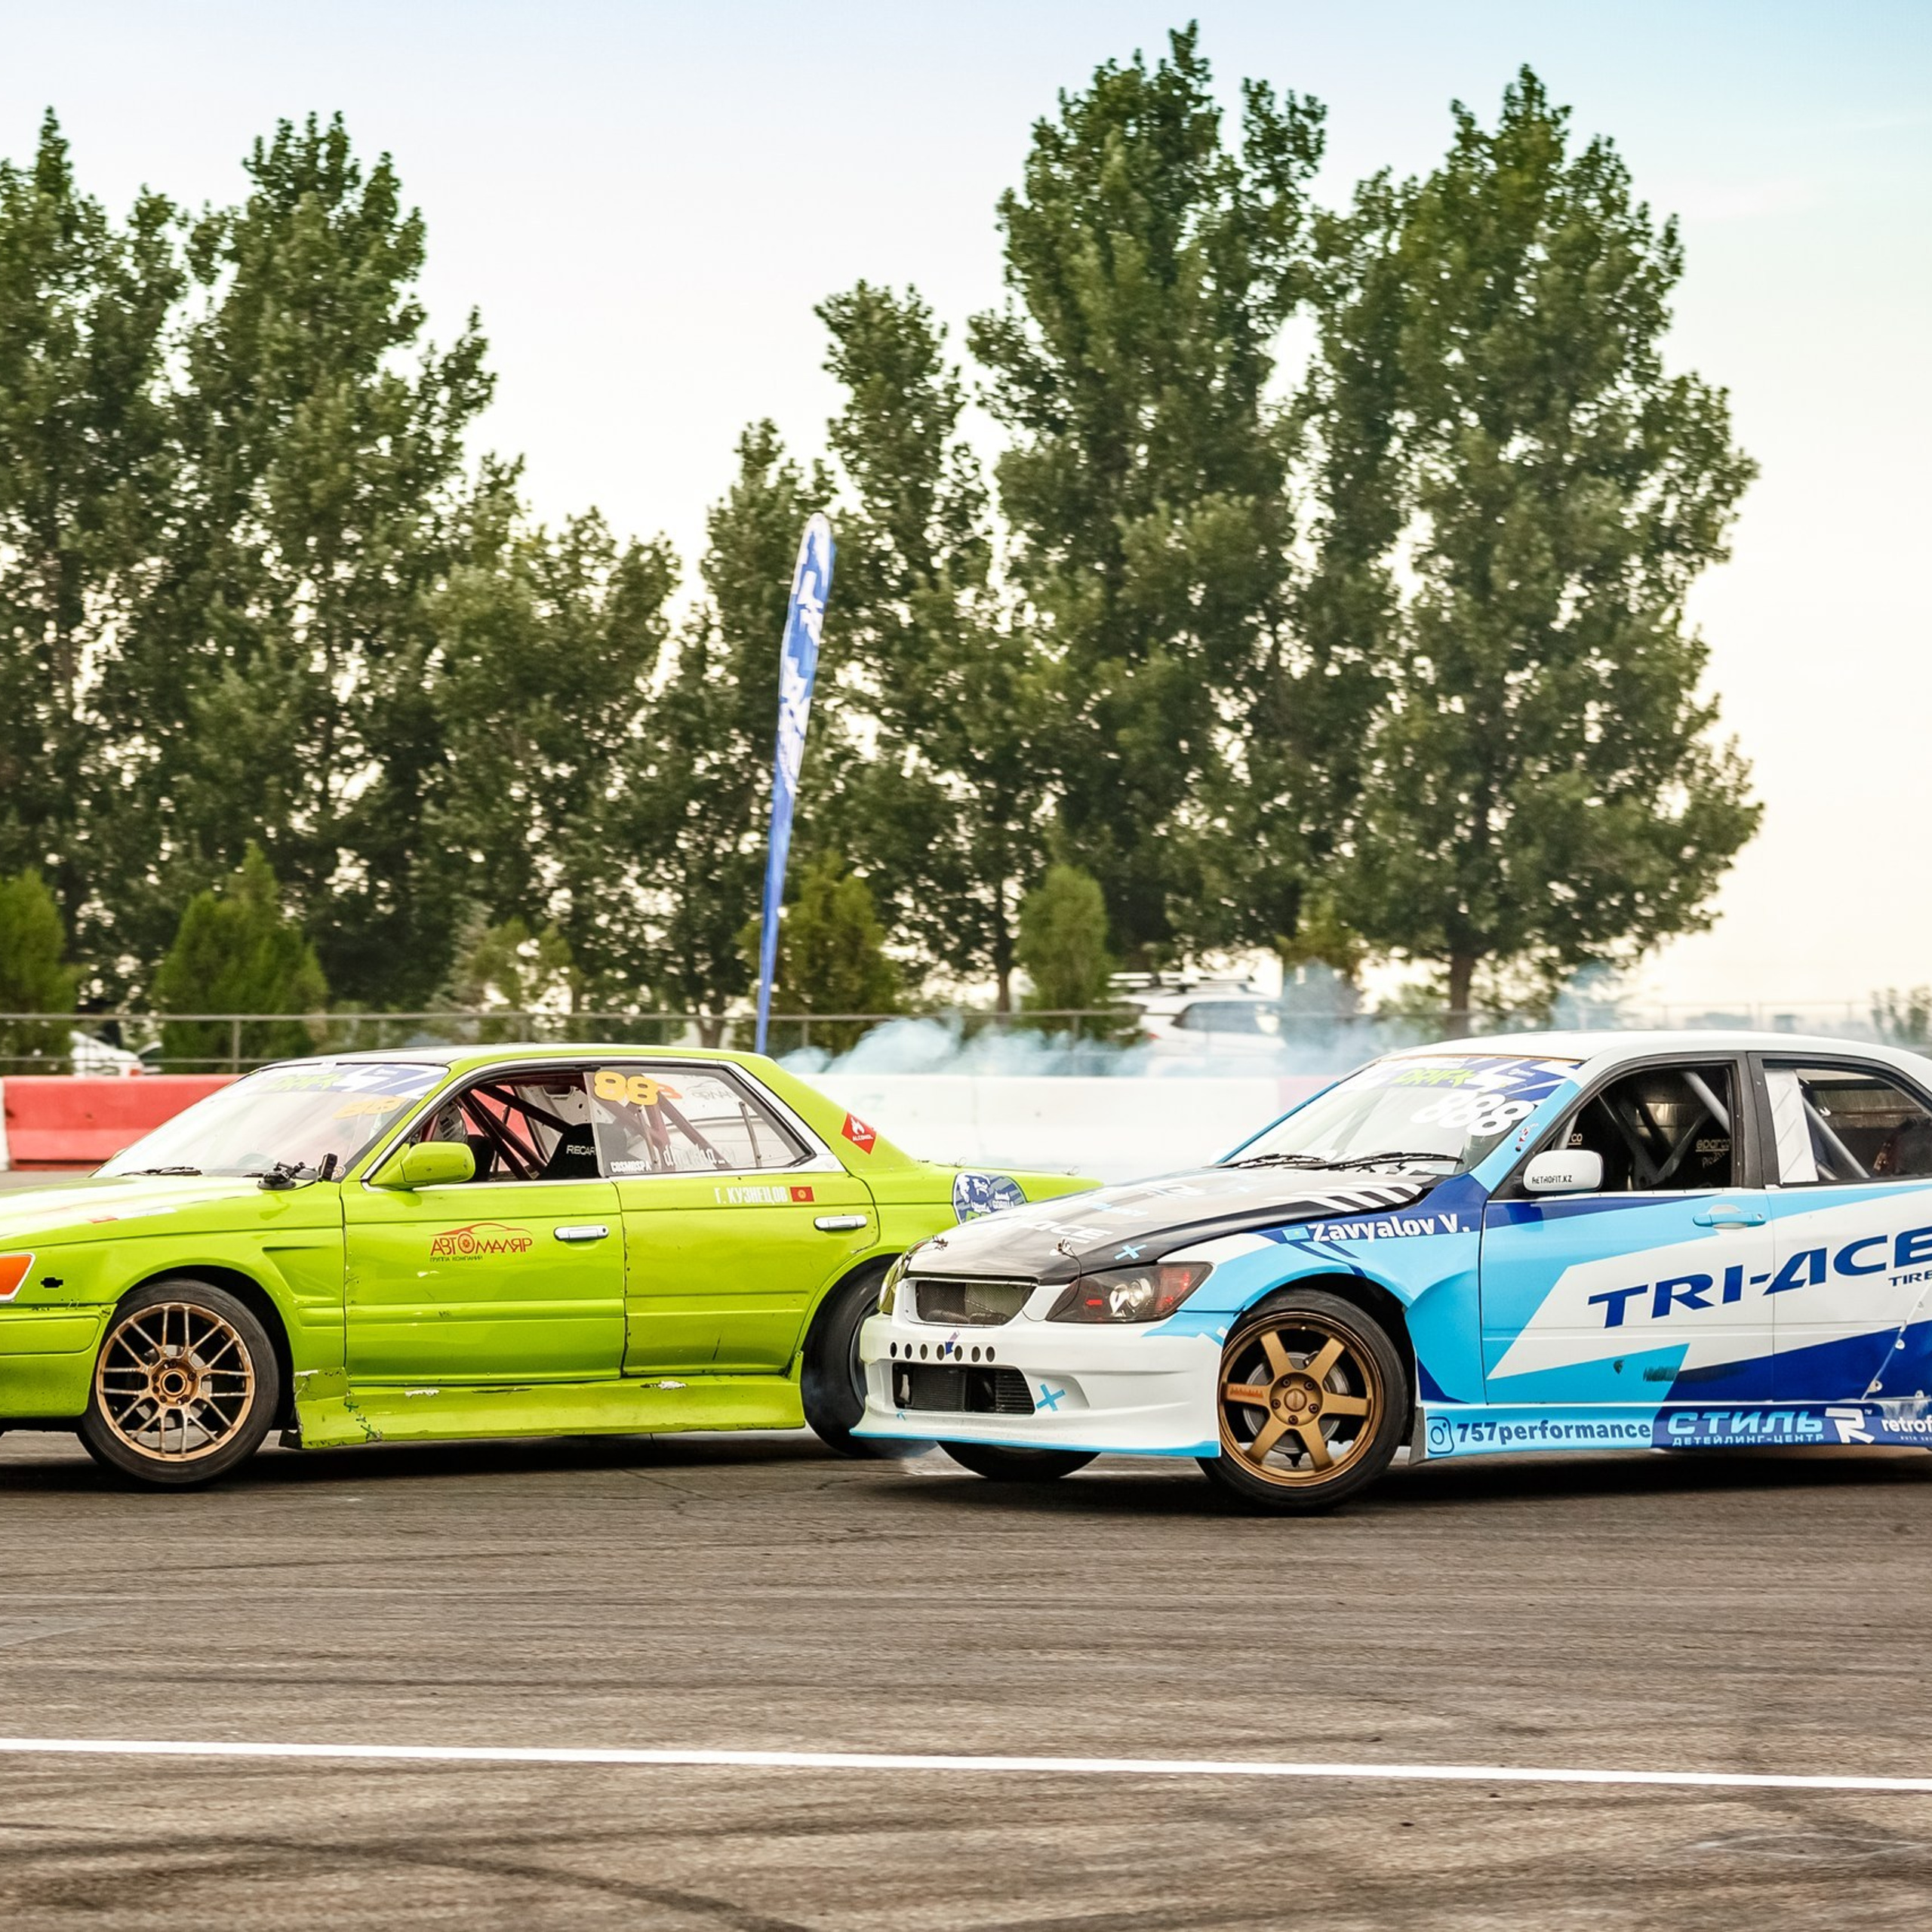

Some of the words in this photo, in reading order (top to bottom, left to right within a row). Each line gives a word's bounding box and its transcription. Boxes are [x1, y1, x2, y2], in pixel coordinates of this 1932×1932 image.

[594, 1071, 661, 1106] 88
[1410, 1092, 1535, 1137] 888
[726, 1186, 788, 1205] КУЗНЕЦОВ
[1307, 1216, 1435, 1242] Zavyalov
[1438, 1214, 1470, 1234] V.
[1587, 1225, 1932, 1329] TRI-ACE
[1457, 1420, 1651, 1445] 757performance
[1668, 1411, 1823, 1435] СТИЛЬ
[1672, 1434, 1825, 1447] ДЕТЕЙЛИНГ-ЦЕНТР
